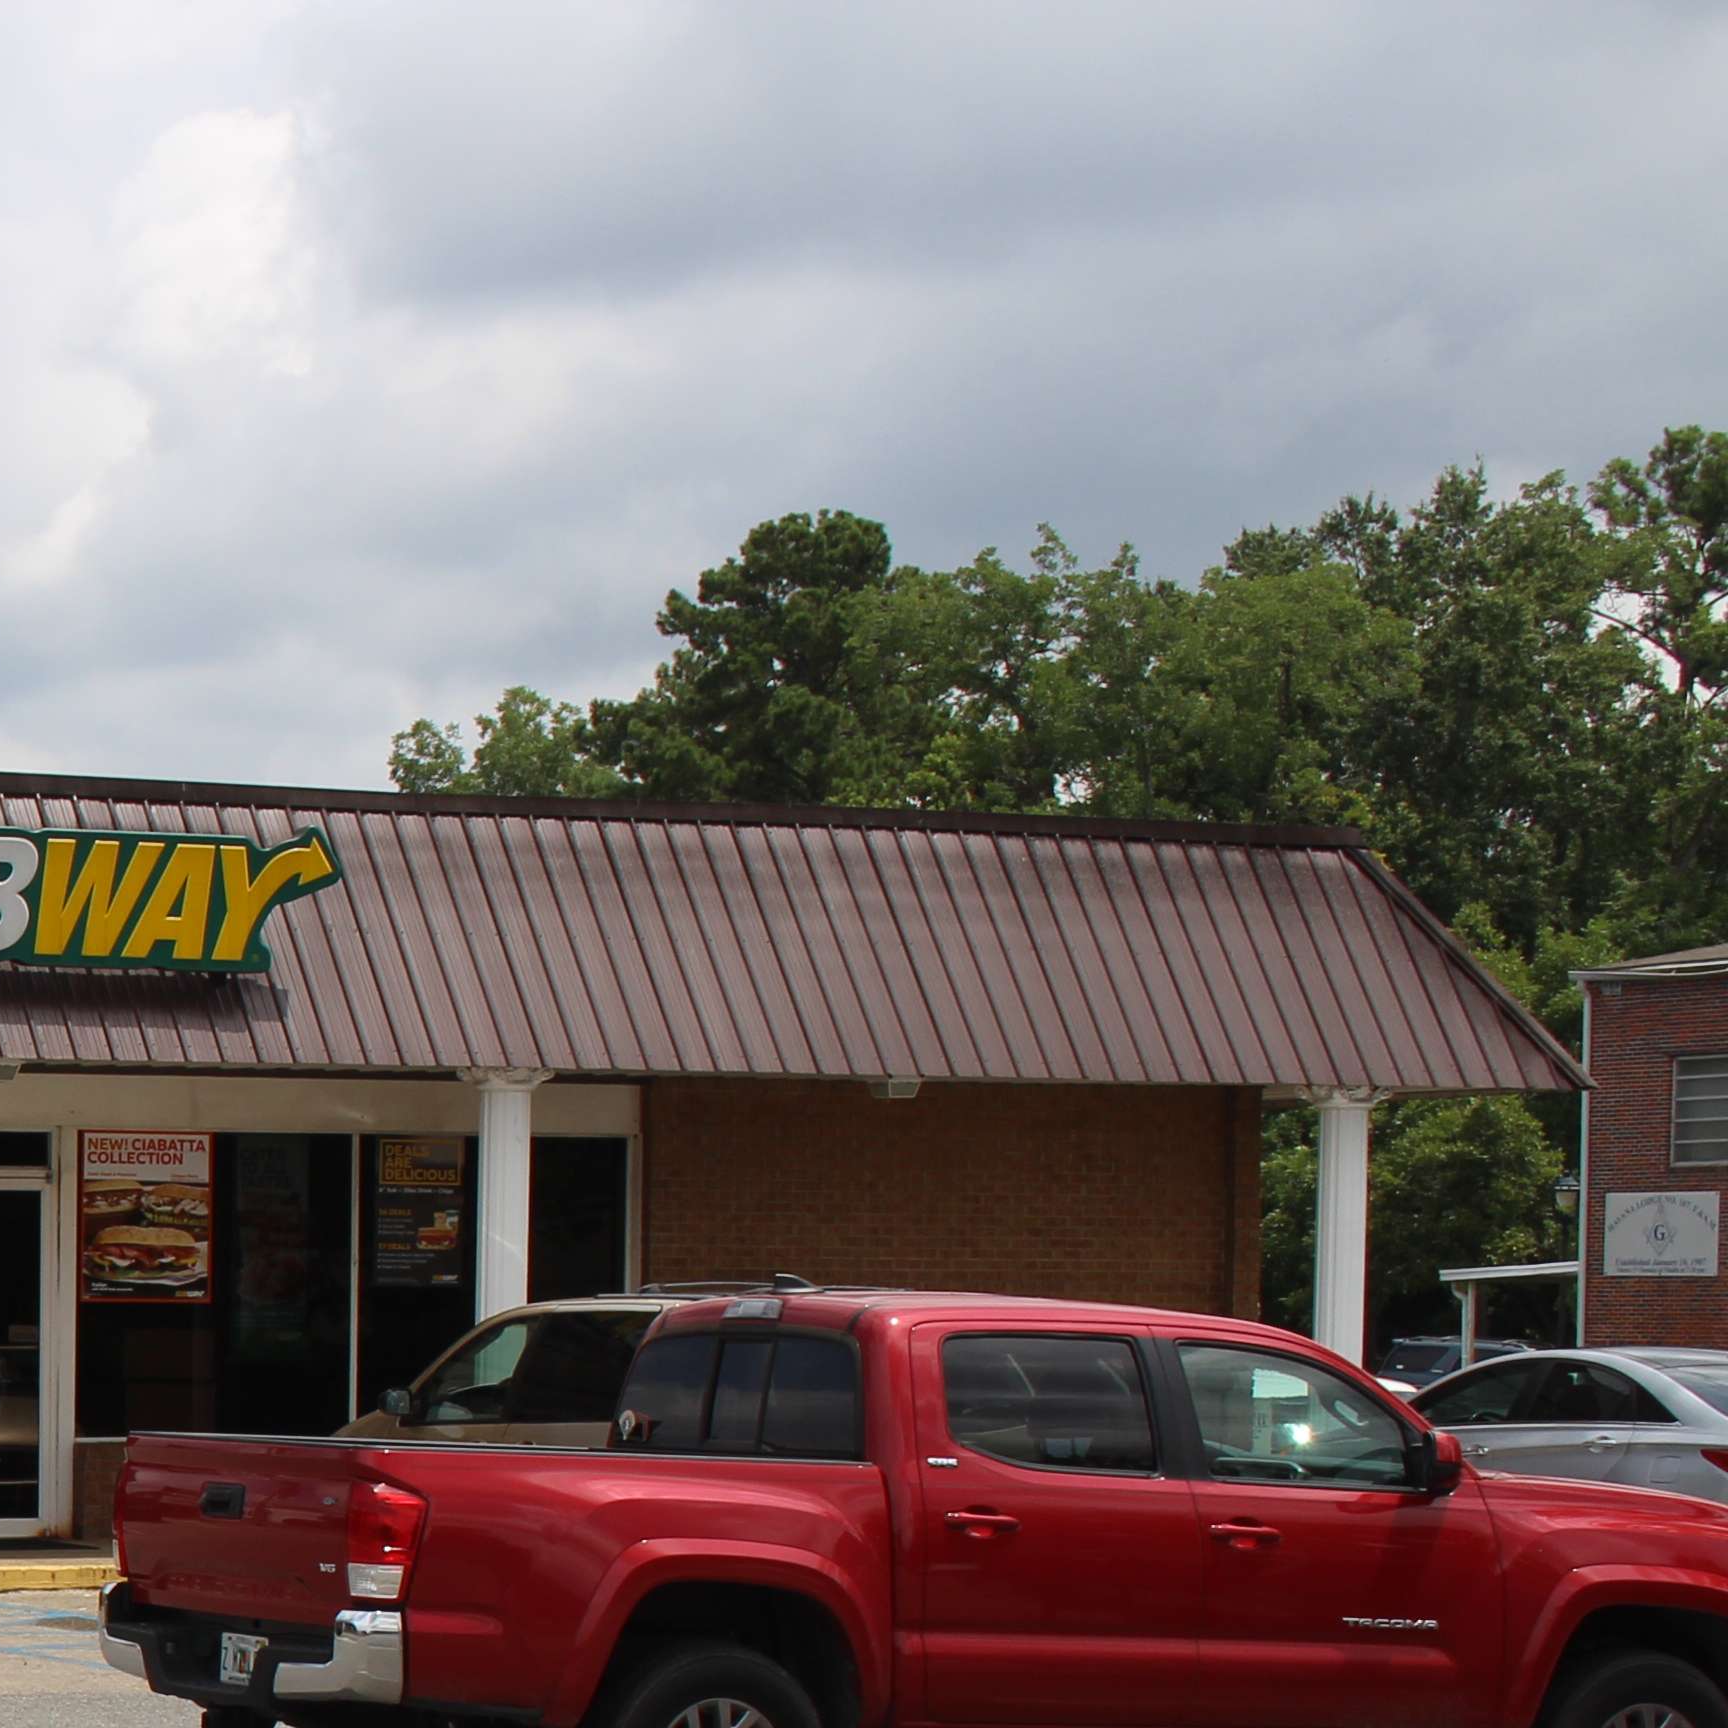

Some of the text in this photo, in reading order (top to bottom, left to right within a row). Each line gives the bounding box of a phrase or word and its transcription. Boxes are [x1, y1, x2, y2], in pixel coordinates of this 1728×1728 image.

[87, 1137, 206, 1153] NEW! CIABATTA
[384, 1144, 431, 1157] DEALS
[87, 1151, 184, 1165] COLLECTION
[384, 1156, 413, 1168] ARE
[384, 1168, 457, 1181] DELICIOUS
[1654, 1224, 1665, 1241] G
[1342, 1616, 1440, 1630] TACOMA
